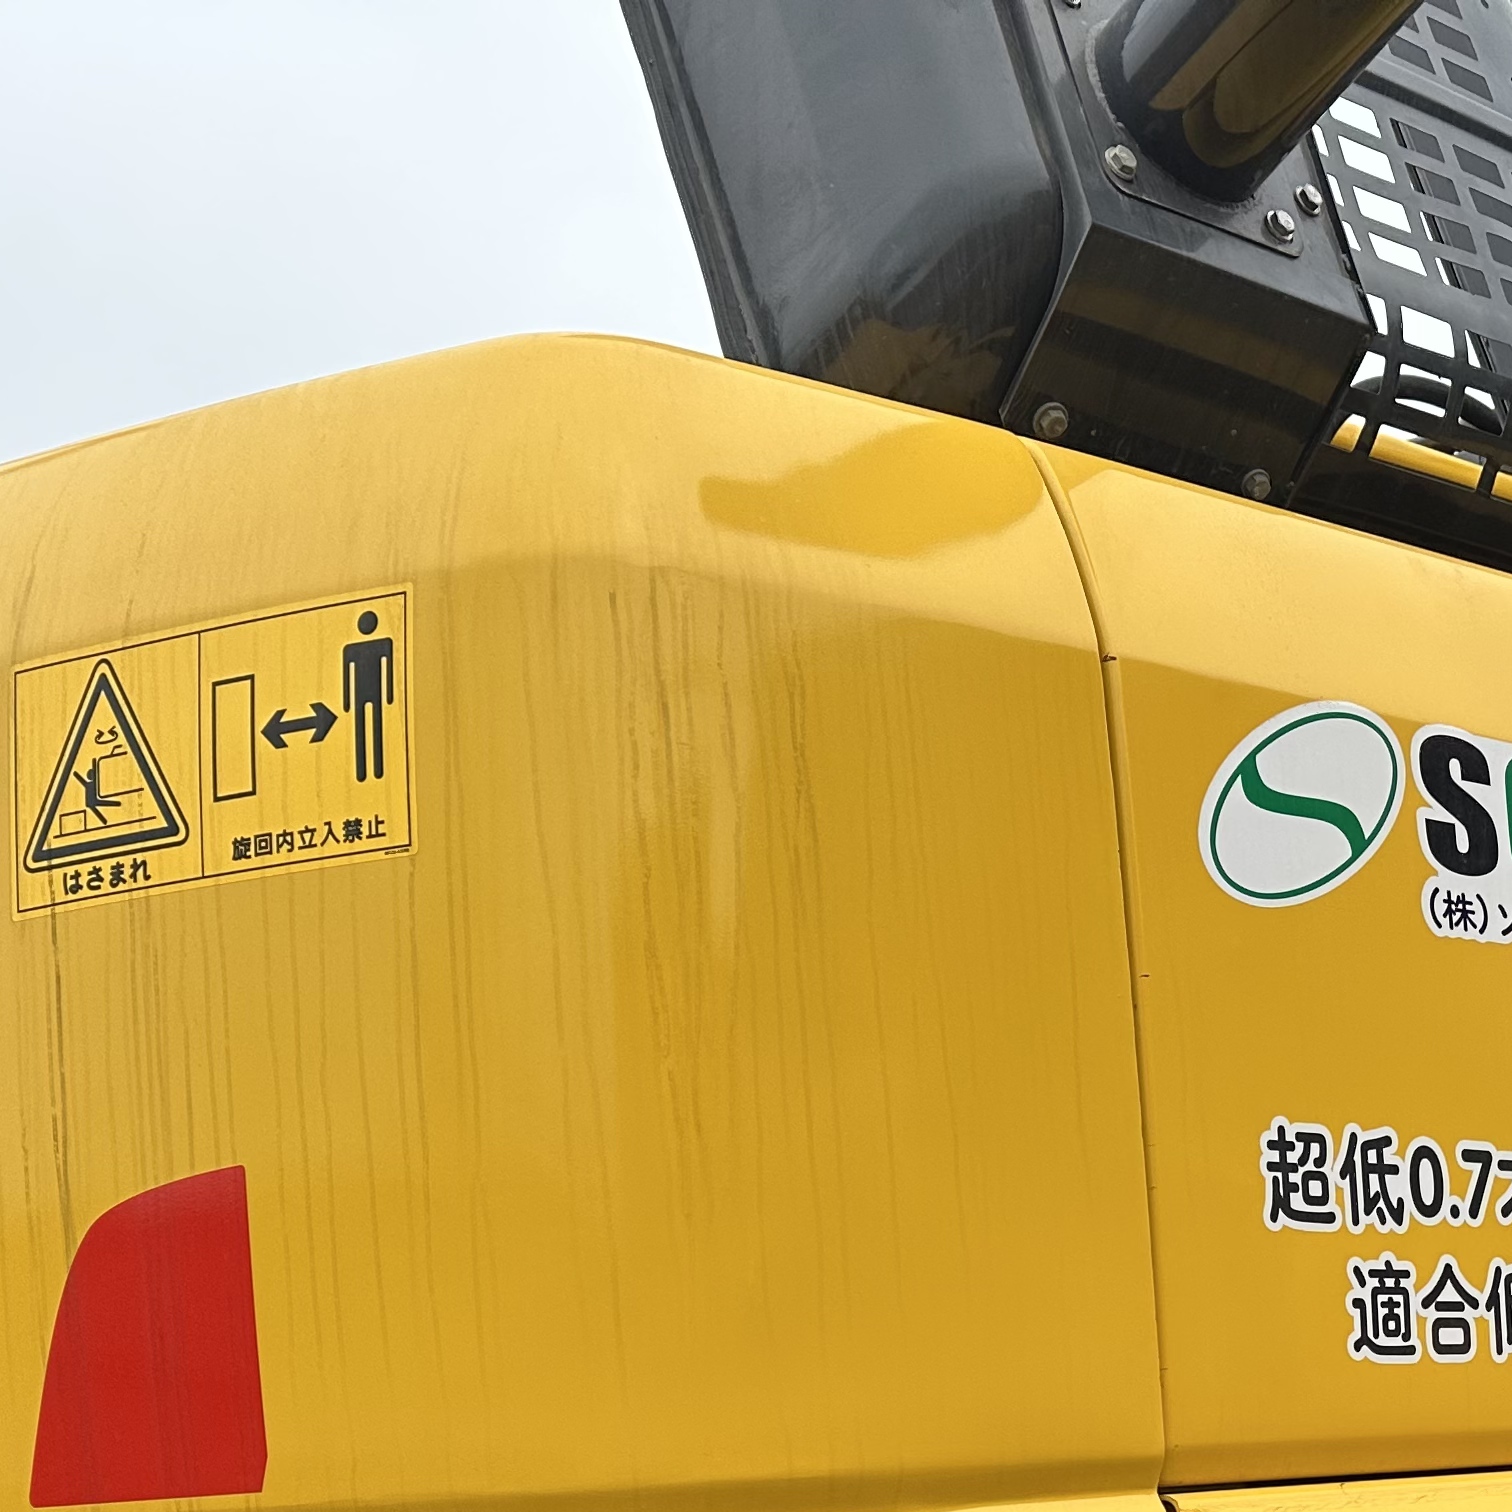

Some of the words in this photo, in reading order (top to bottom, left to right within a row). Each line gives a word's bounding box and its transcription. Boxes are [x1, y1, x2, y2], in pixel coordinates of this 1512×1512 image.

[231, 814, 387, 862] 旋回内立入禁止
[62, 858, 152, 896] はさまれ
